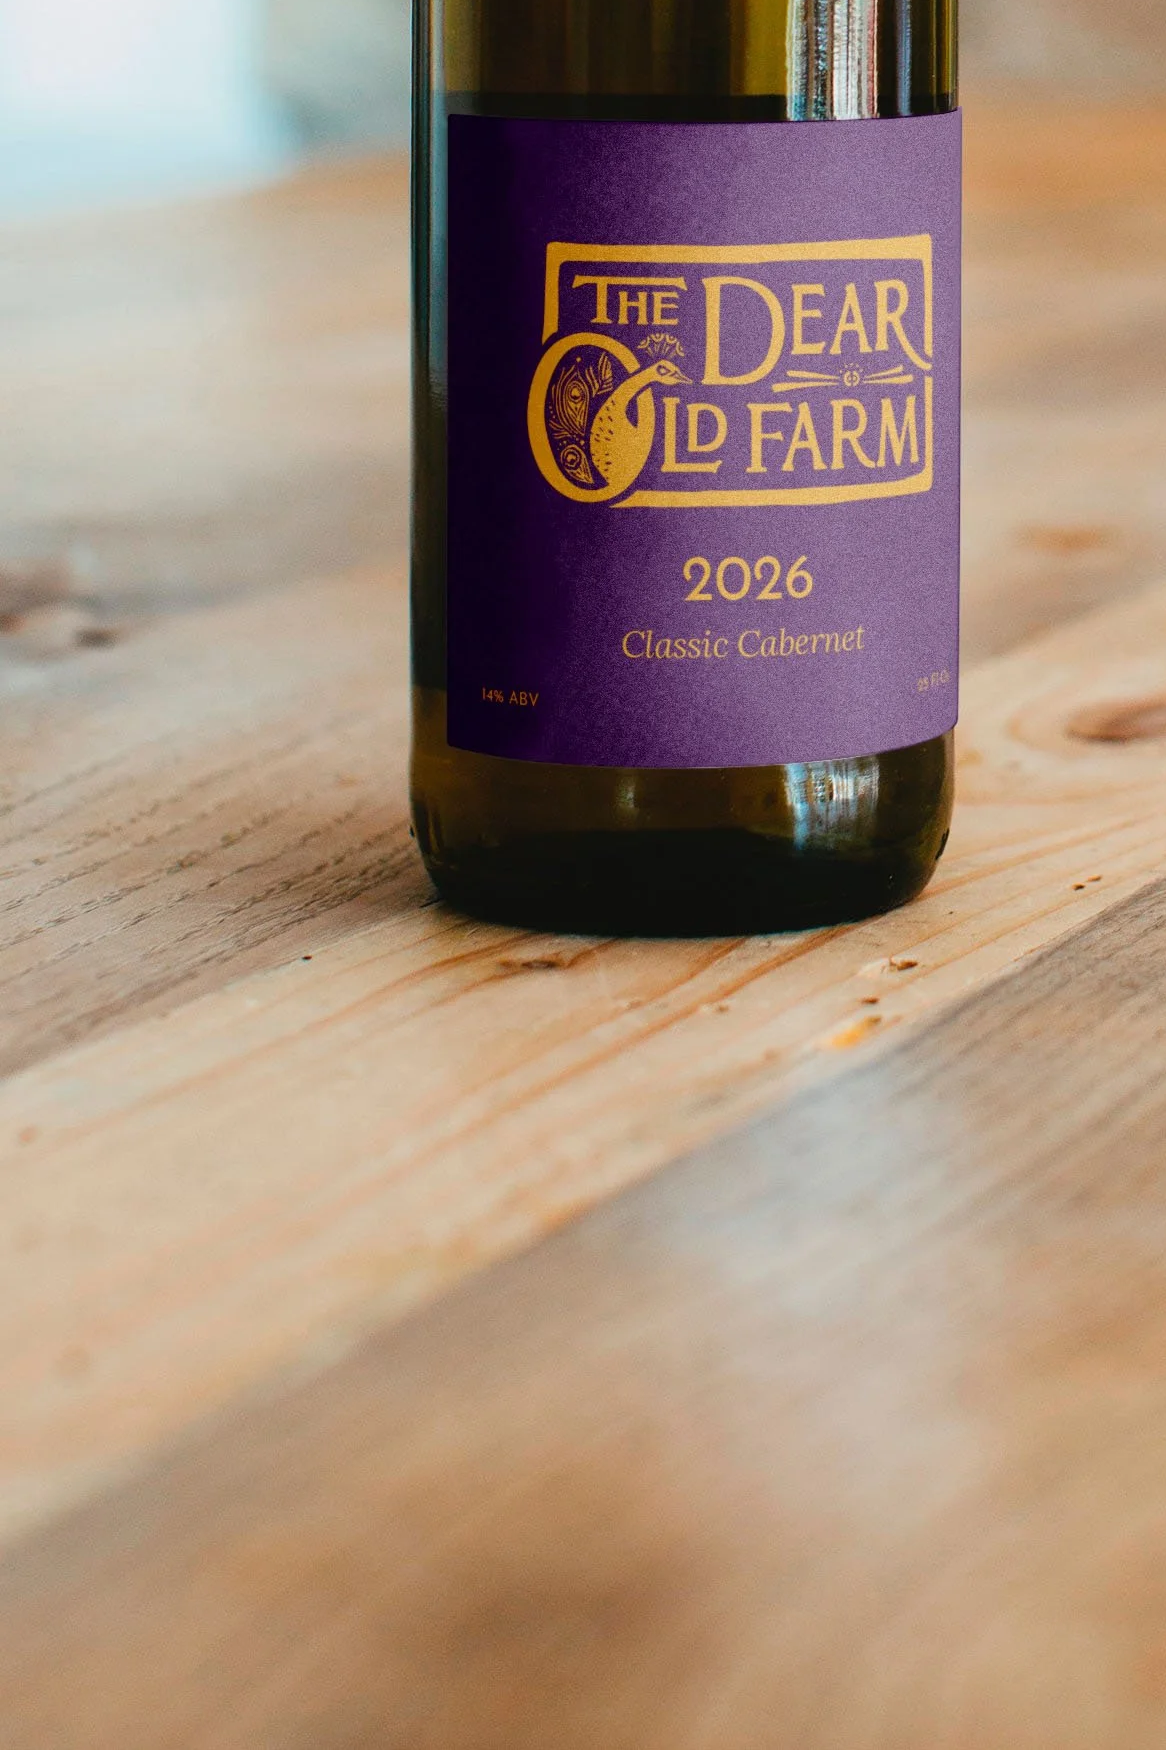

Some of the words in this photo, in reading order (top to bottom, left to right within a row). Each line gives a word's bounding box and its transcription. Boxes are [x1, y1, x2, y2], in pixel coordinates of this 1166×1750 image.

[572, 274, 688, 326] THE
[701, 275, 932, 387] DEAR
[527, 331, 728, 504] OLD
[746, 394, 920, 474] FARM
[683, 555, 815, 602] 2026
[621, 630, 730, 660] Classic
[736, 626, 866, 659] Cabernet
[482, 687, 504, 703] 14%
[509, 690, 539, 707] ABV
